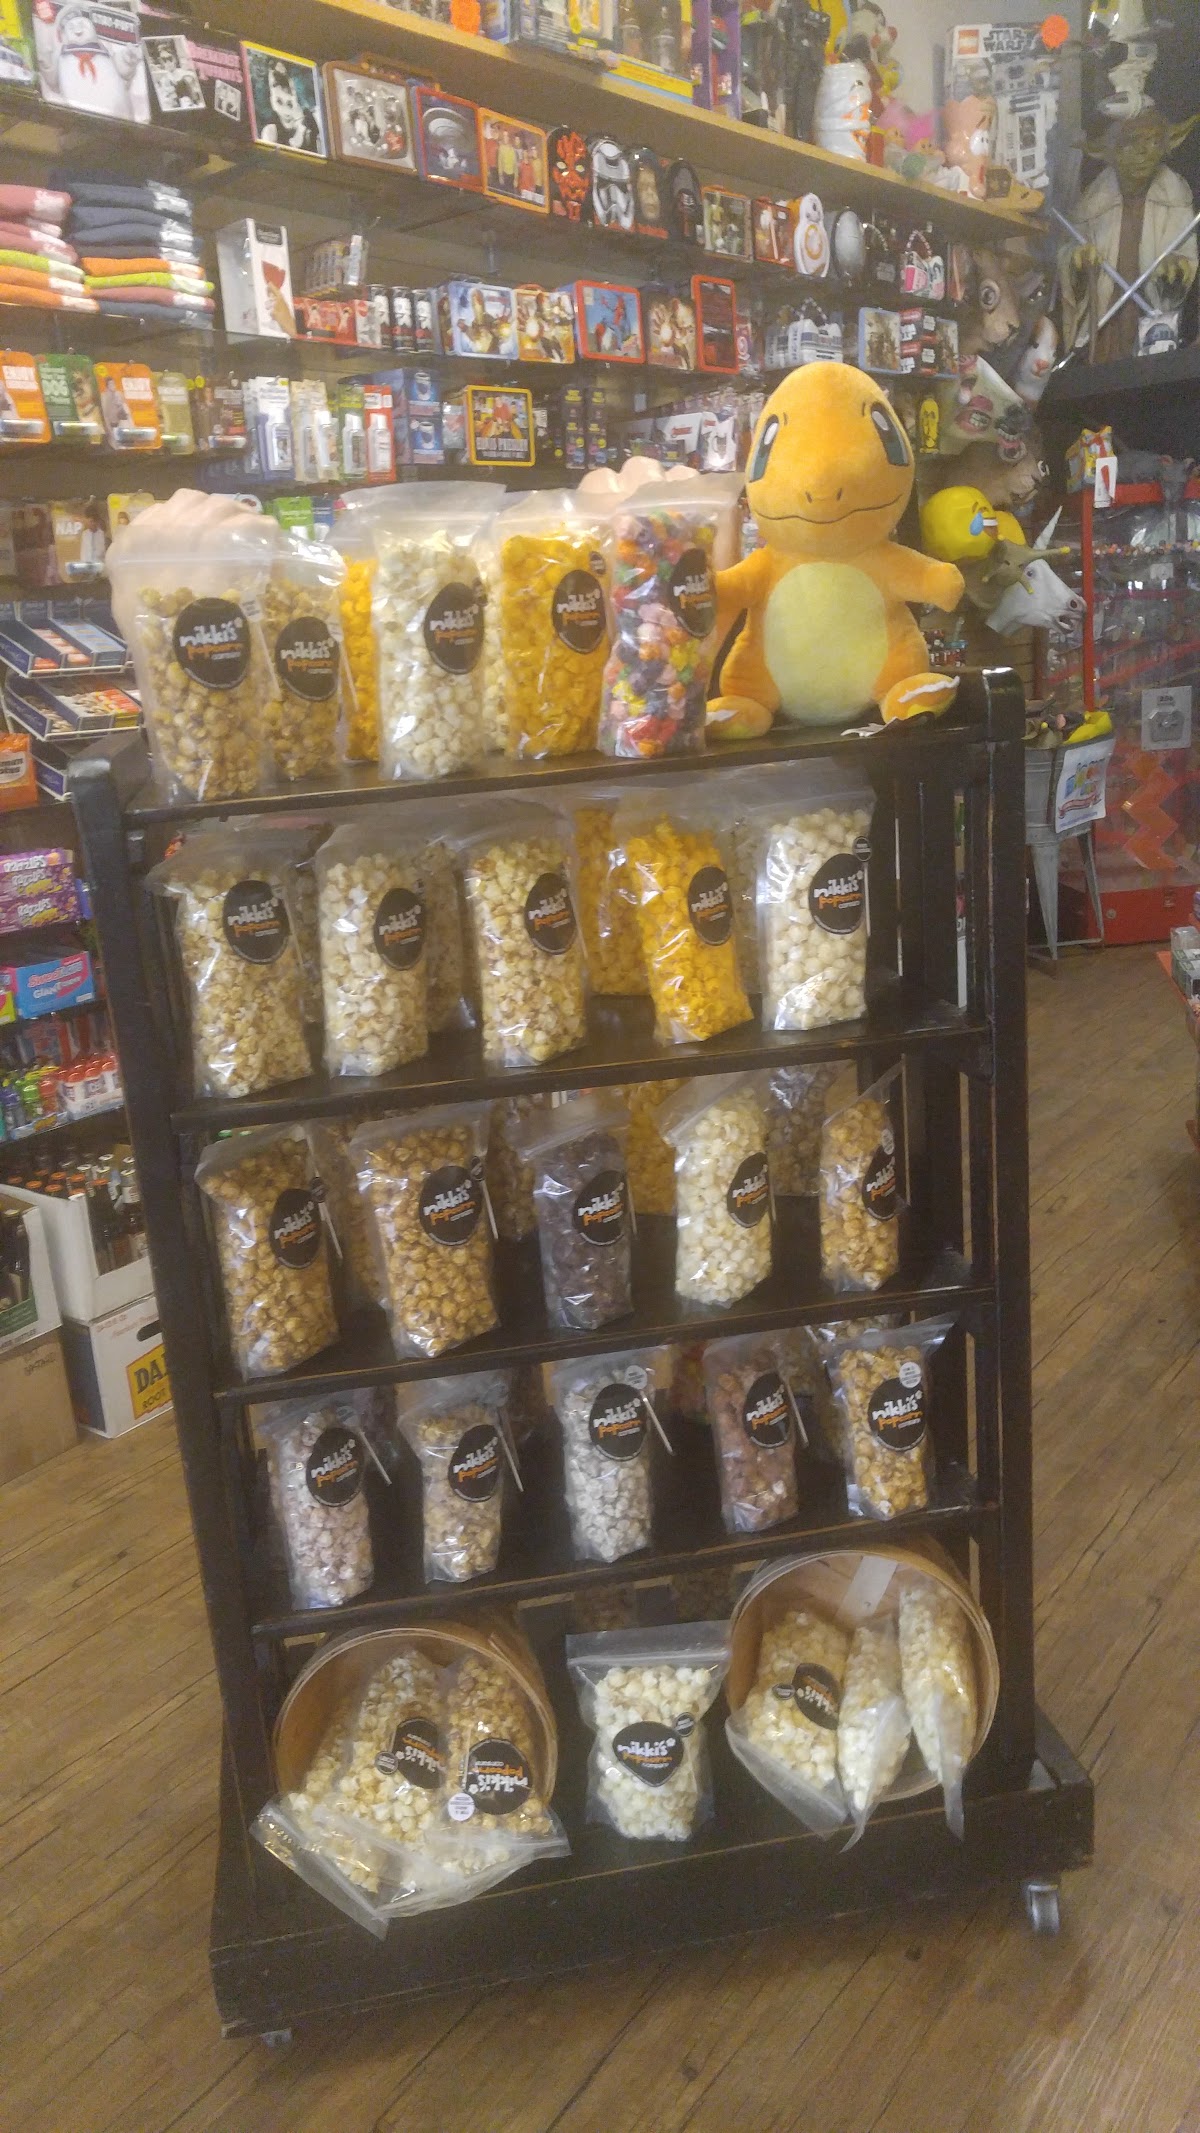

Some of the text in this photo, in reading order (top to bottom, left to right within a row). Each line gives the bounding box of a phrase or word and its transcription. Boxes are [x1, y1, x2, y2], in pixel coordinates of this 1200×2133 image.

[984, 29, 1025, 41] STAR
[984, 40, 1024, 52] WARS
[179, 621, 239, 648] nikki's
[813, 874, 859, 898] nikki's
[423, 1186, 471, 1216] nikki's
[593, 1401, 638, 1428] nikki's
[872, 1394, 918, 1421] nikki's
[617, 1740, 668, 1757] nikki's
[477, 1774, 528, 1792] nikki's
